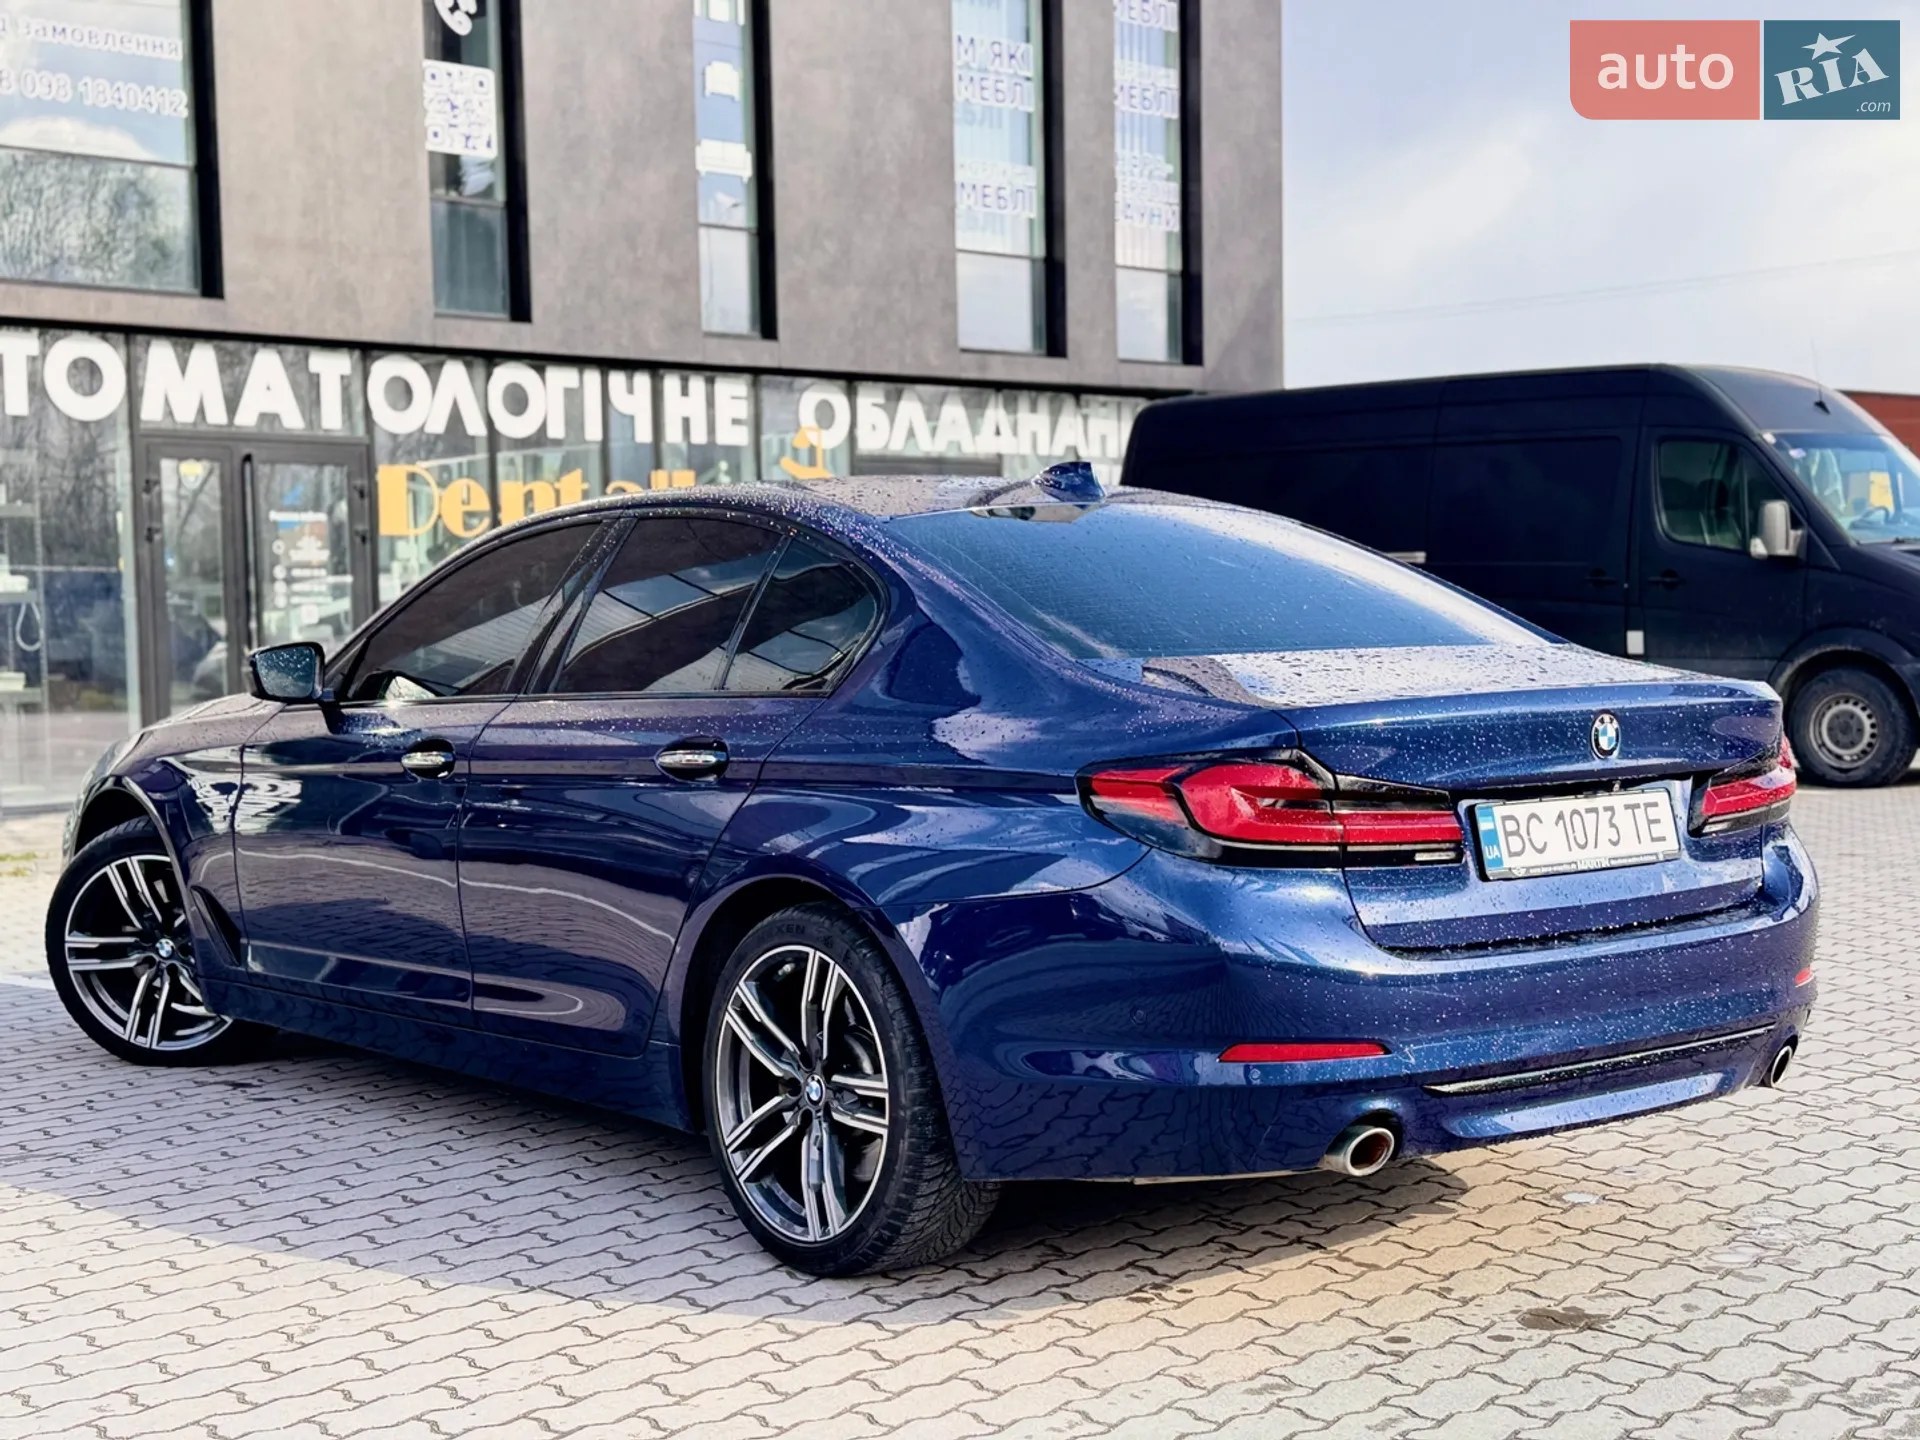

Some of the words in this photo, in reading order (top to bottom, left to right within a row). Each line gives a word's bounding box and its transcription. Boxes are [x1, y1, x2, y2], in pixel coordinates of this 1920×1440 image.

[21, 70, 73, 104] 098
[1501, 811, 1547, 858] BC
[1555, 805, 1621, 853] 1073
[1624, 801, 1667, 845] TE
